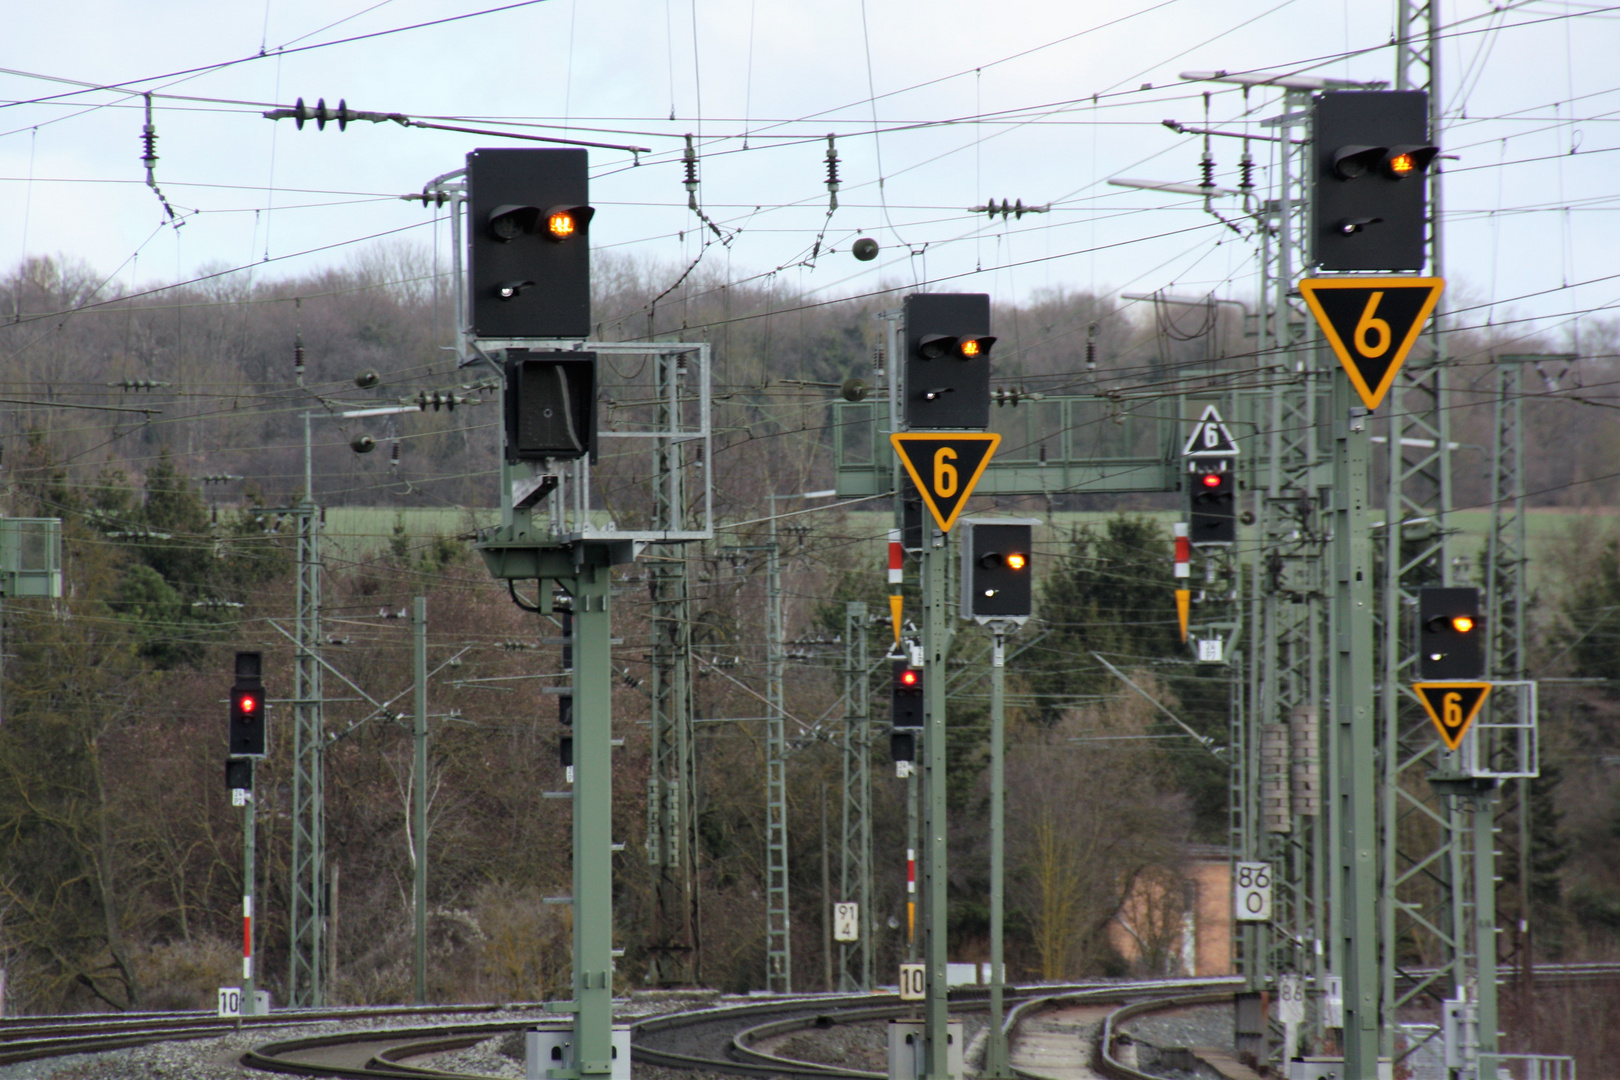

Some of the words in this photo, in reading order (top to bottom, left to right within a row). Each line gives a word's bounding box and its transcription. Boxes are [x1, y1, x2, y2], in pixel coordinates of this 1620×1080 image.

[1354, 291, 1391, 359] 6
[1204, 422, 1219, 448] 6
[933, 446, 958, 498] 6
[1442, 691, 1463, 728] 6
[1239, 866, 1270, 888] 86
[838, 905, 854, 920] 91
[1246, 891, 1263, 914] 0
[842, 922, 850, 937] 4
[902, 968, 923, 994] 10
[1282, 984, 1302, 1001] 86
[220, 992, 238, 1013] 10
